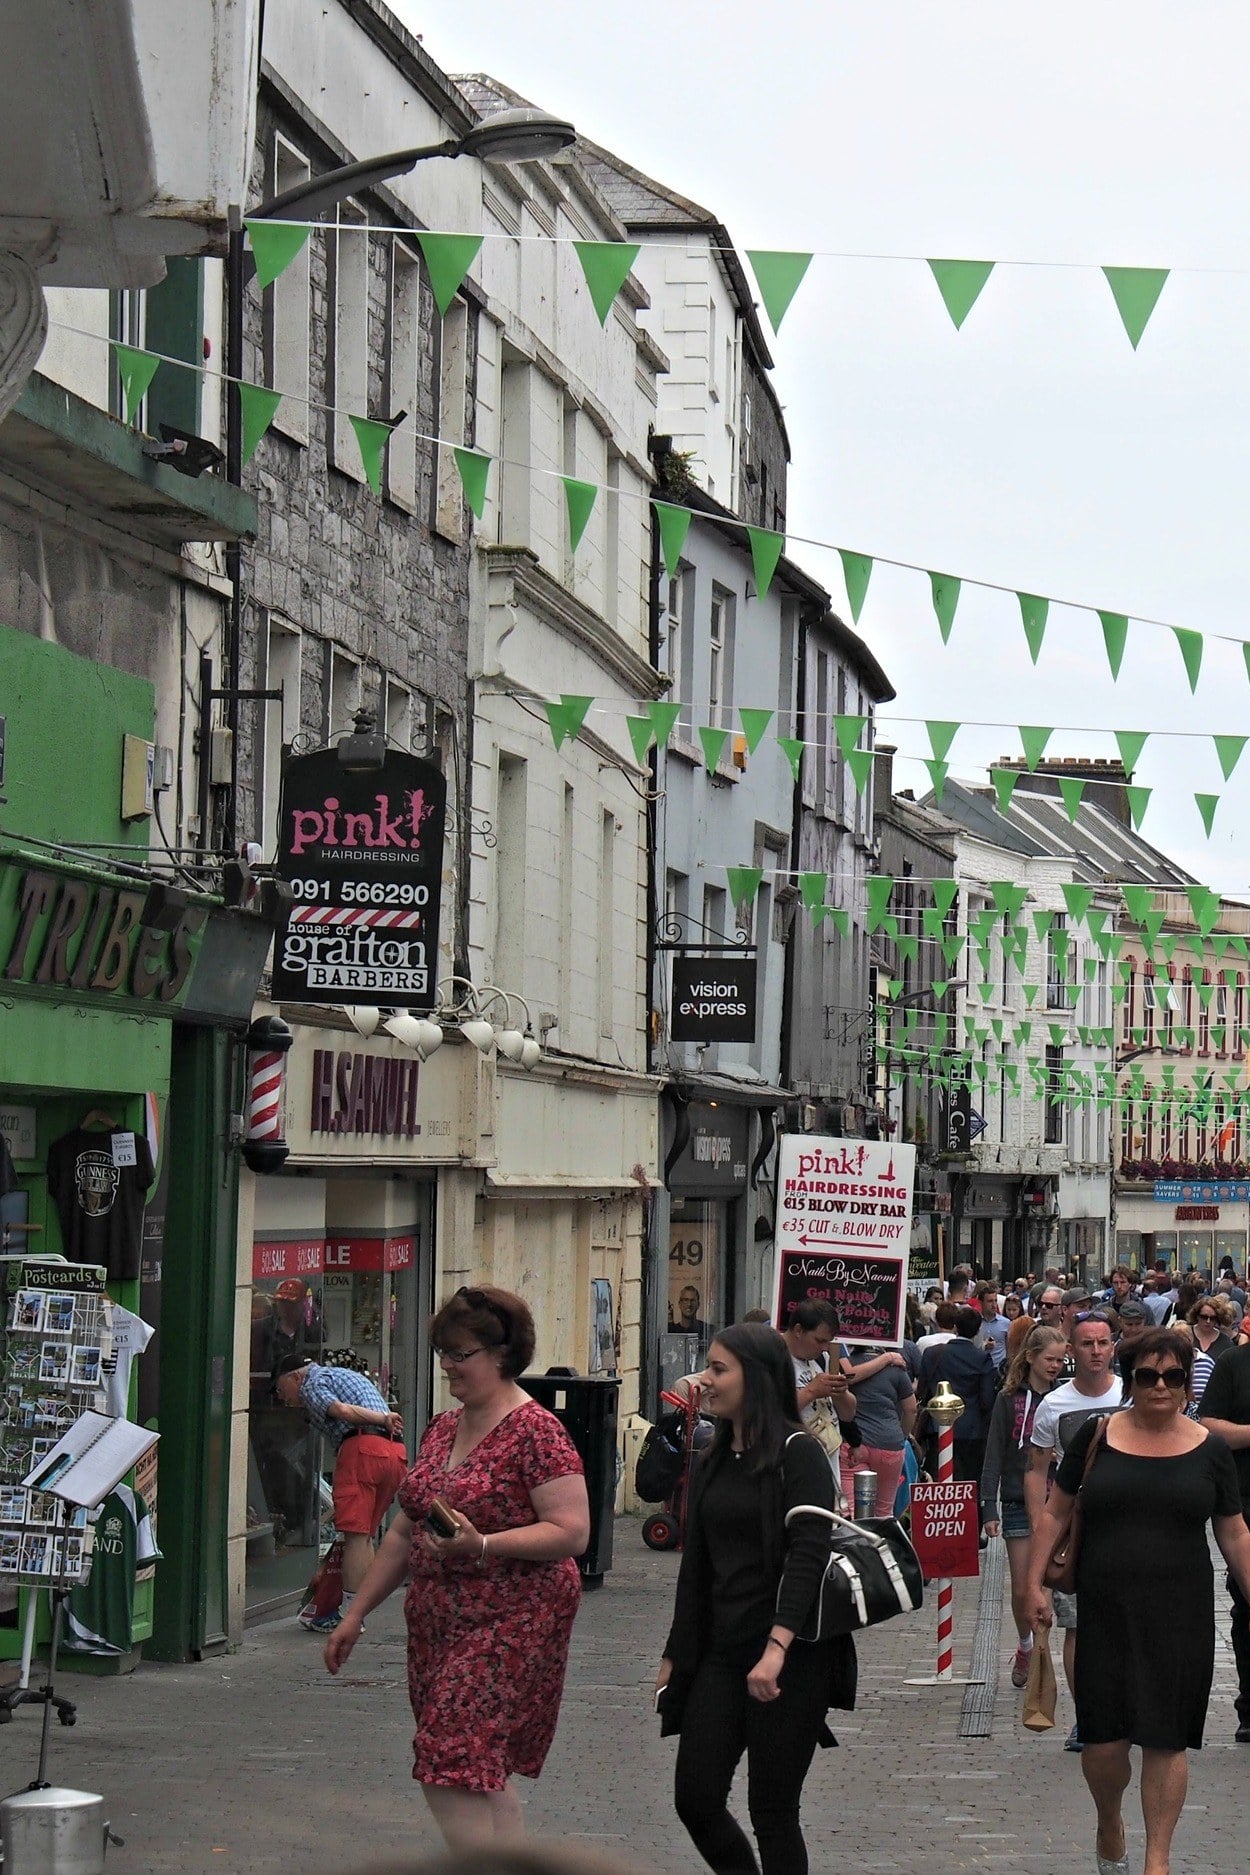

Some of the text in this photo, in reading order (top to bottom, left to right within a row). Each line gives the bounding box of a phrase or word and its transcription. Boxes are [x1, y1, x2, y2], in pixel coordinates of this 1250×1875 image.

[290, 789, 434, 854] pink!
[321, 850, 420, 863] HAIRDRESSING
[290, 879, 429, 905] 091 566290
[287, 921, 353, 935] house of
[281, 925, 429, 971] grafton
[312, 968, 424, 989] BARBERS
[690, 982, 737, 997] vision
[680, 1002, 747, 1018] express
[950, 1111, 965, 1149] Cafe
[798, 1145, 869, 1177] pink!
[77, 1166, 117, 1180] GUINNESS
[785, 1179, 907, 1199] HAIRDRESSING
[784, 1197, 907, 1218] €15 BLOW DRY BAR
[783, 1218, 804, 1232] €35
[809, 1219, 830, 1234] CUT
[843, 1222, 876, 1237] BLOW
[879, 1224, 904, 1239] DRY
[272, 1250, 285, 1271] SALE
[307, 1248, 320, 1269] SALE
[326, 1245, 350, 1264] LE
[398, 1244, 409, 1265] SALE
[788, 1259, 897, 1287] Nails By Naomi
[909, 1261, 938, 1270] weater
[24, 1269, 92, 1286] Postcards
[807, 1287, 831, 1299] Gel
[115, 1335, 128, 1343] €15
[914, 1485, 973, 1501] BARBER
[924, 1502, 964, 1519] SHOP
[925, 1520, 966, 1537] OPEN
